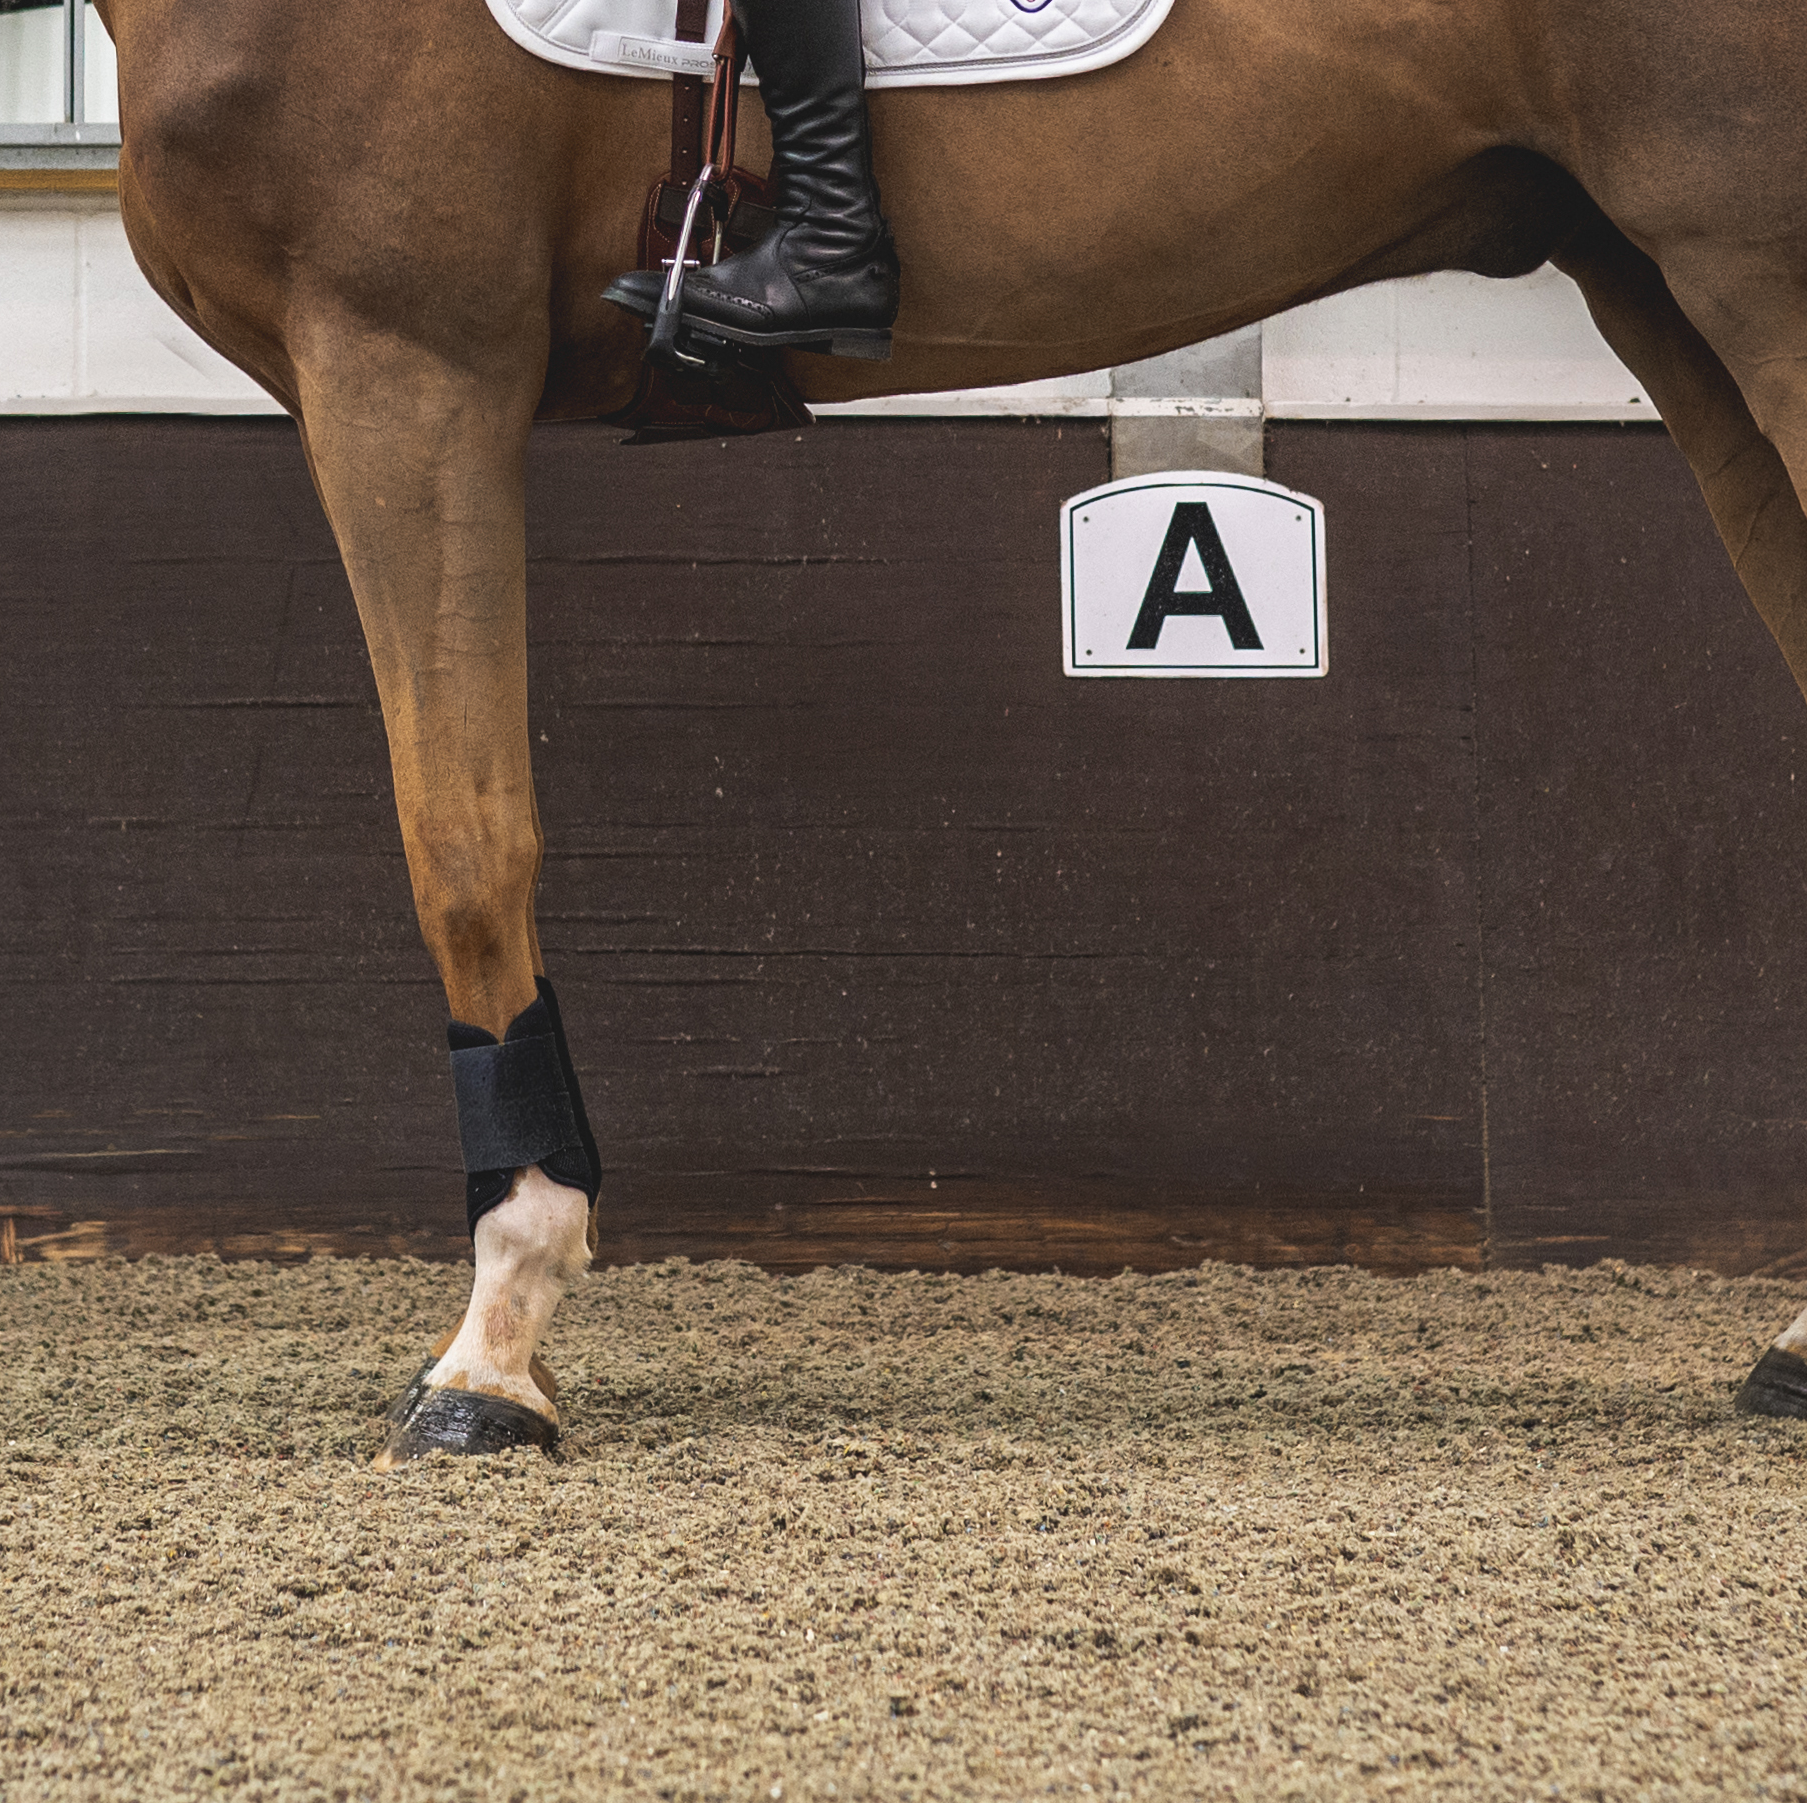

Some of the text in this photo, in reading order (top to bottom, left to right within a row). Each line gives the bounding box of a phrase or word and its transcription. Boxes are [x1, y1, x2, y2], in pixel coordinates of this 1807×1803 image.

[622, 43, 716, 69] LeMieux PROS
[1125, 501, 1265, 651] A
